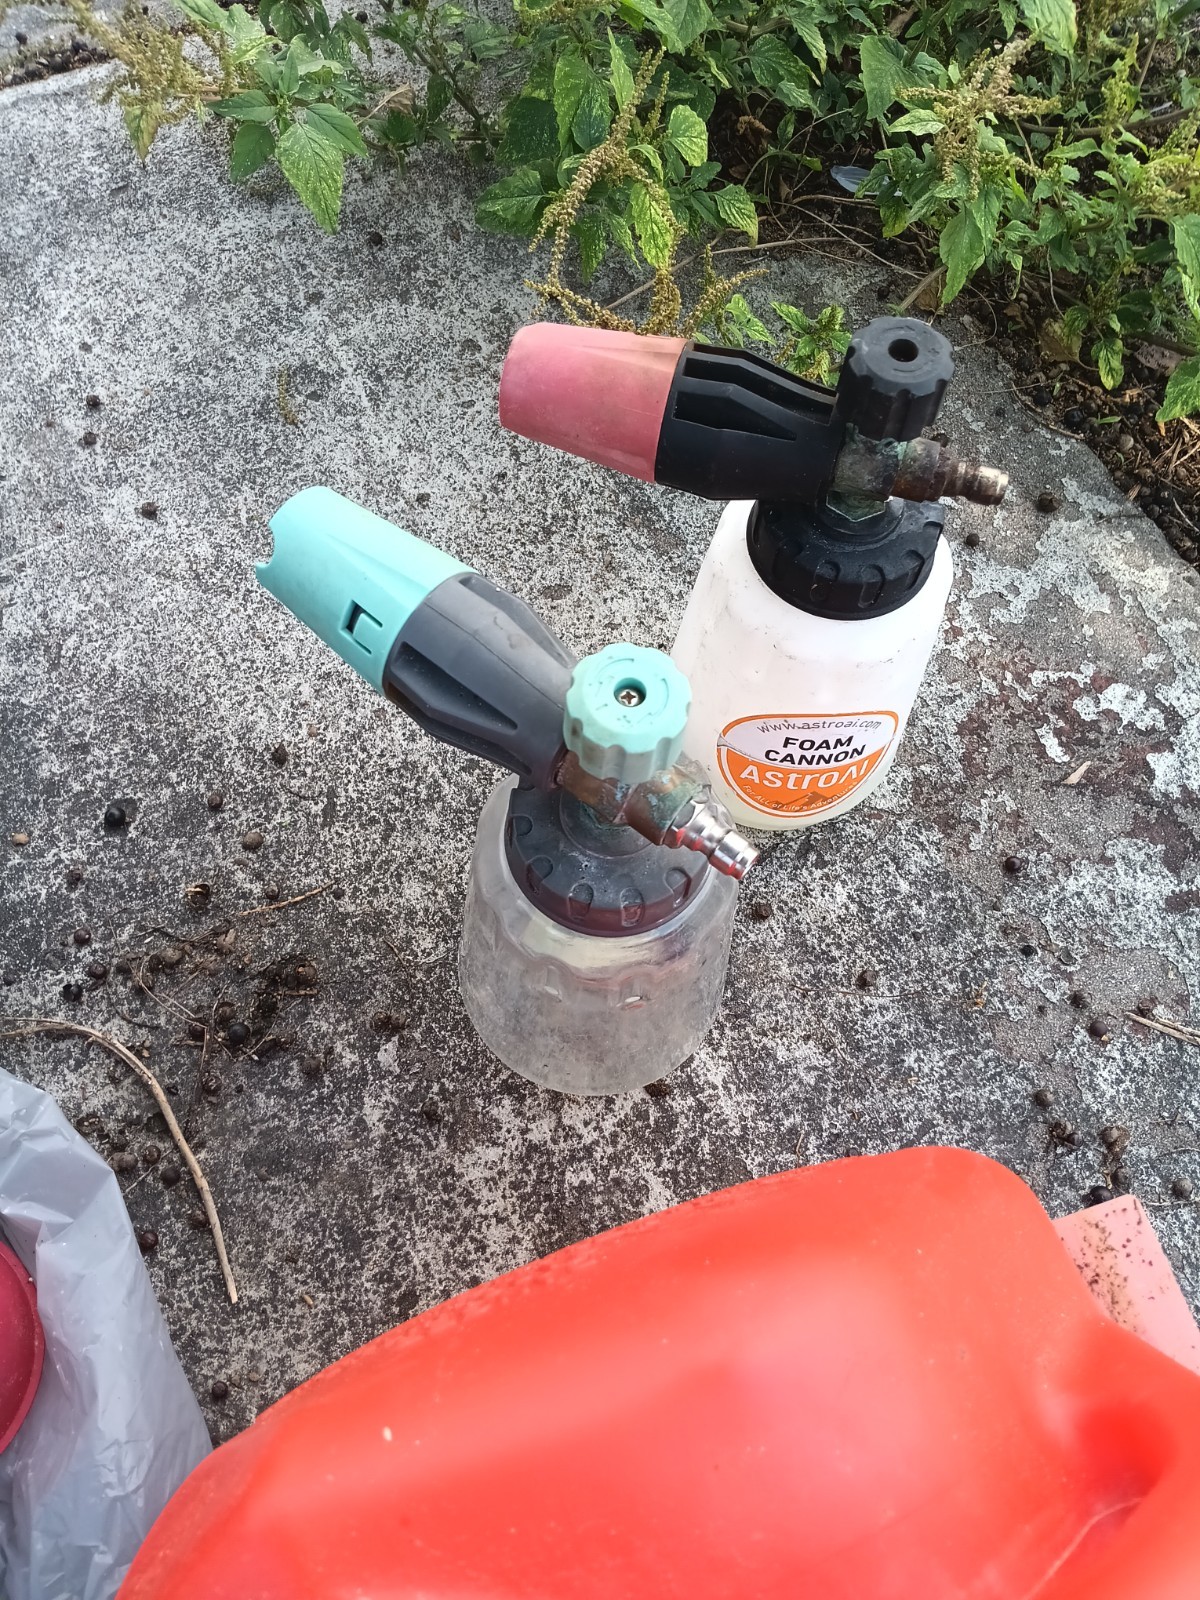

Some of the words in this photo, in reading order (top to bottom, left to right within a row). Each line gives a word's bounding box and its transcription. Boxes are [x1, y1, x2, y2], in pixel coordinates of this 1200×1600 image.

[757, 719, 881, 733] www.astroai.com
[783, 736, 853, 751] FOAM
[765, 745, 866, 765] CANNON
